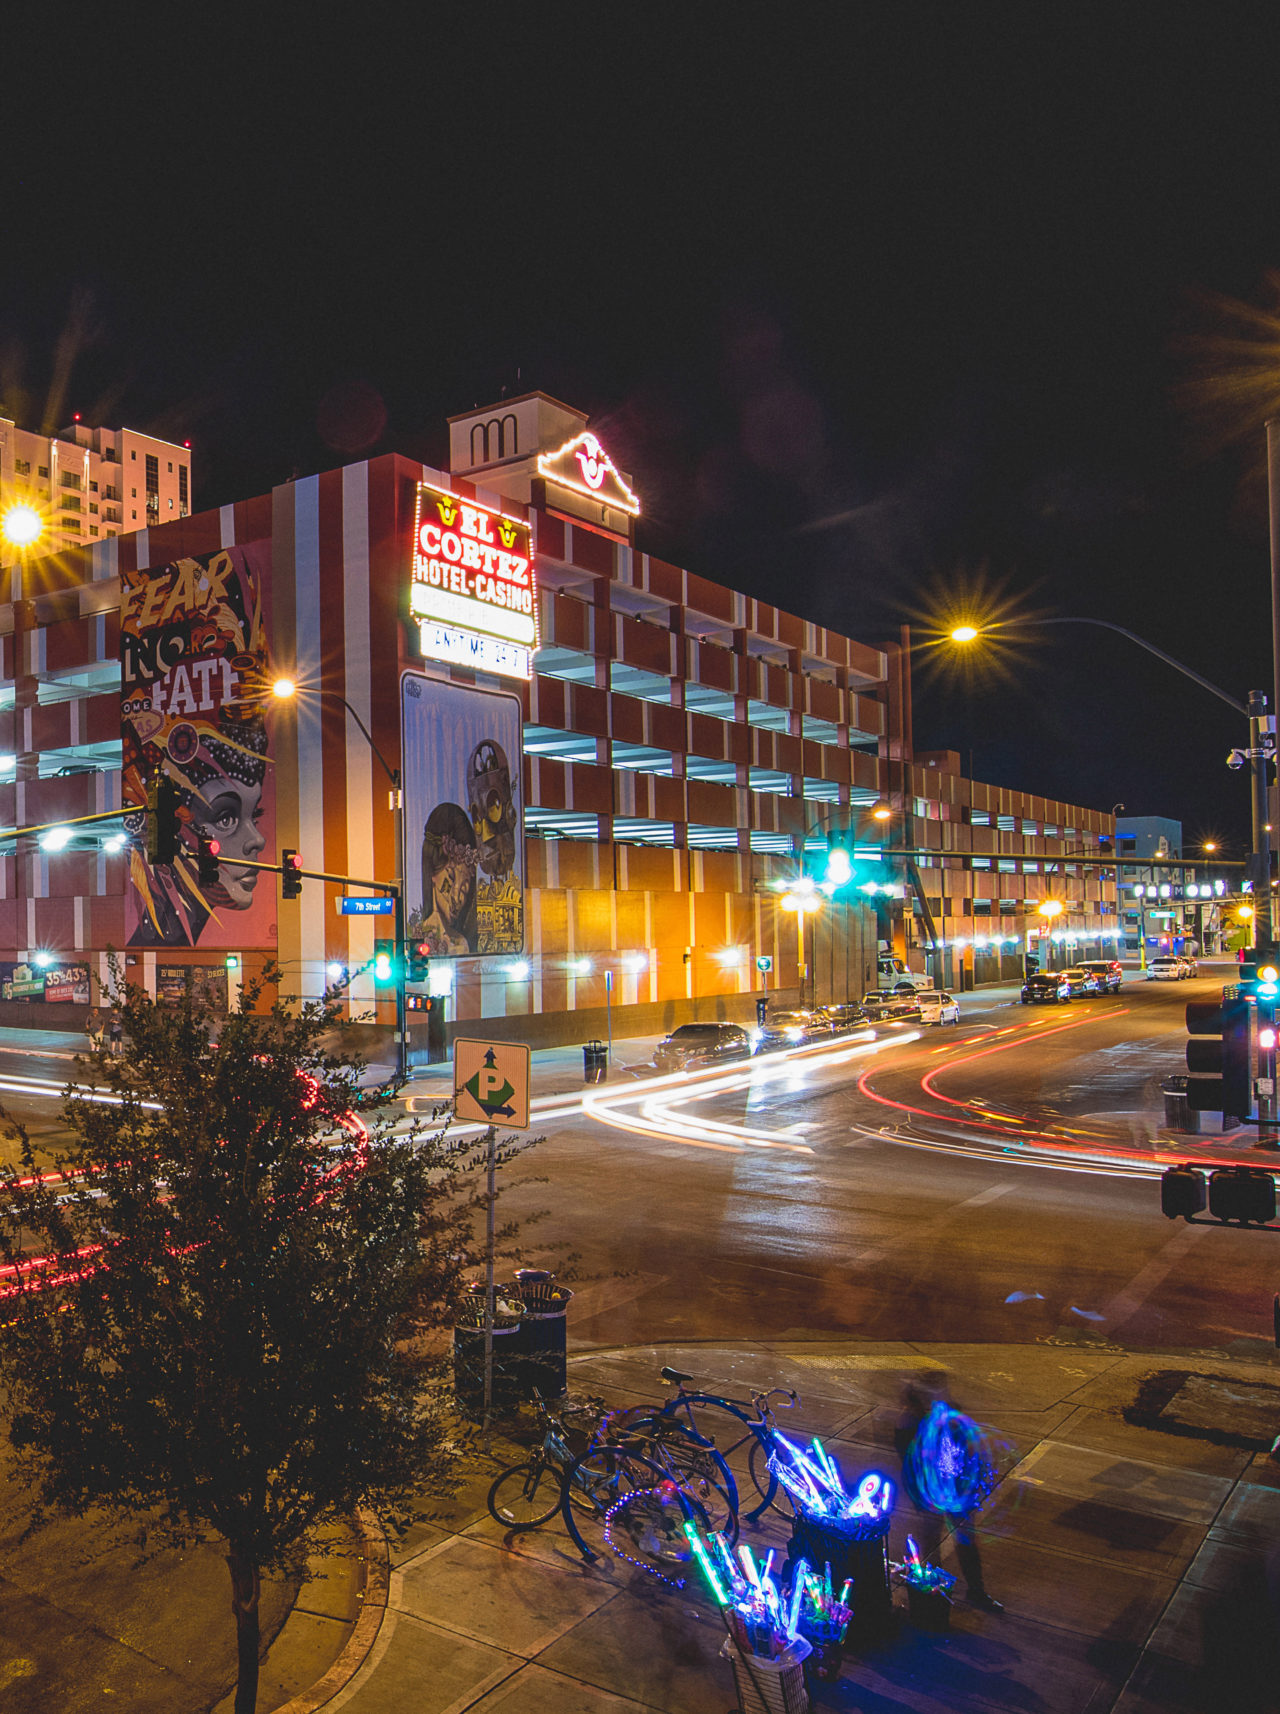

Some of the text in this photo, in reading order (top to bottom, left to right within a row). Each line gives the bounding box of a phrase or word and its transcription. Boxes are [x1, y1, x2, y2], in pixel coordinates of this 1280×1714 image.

[460, 505, 494, 543] EL
[420, 523, 529, 586] CORTEZ
[120, 550, 234, 630] FEAR
[355, 902, 364, 911] 7th
[365, 902, 381, 911] Street
